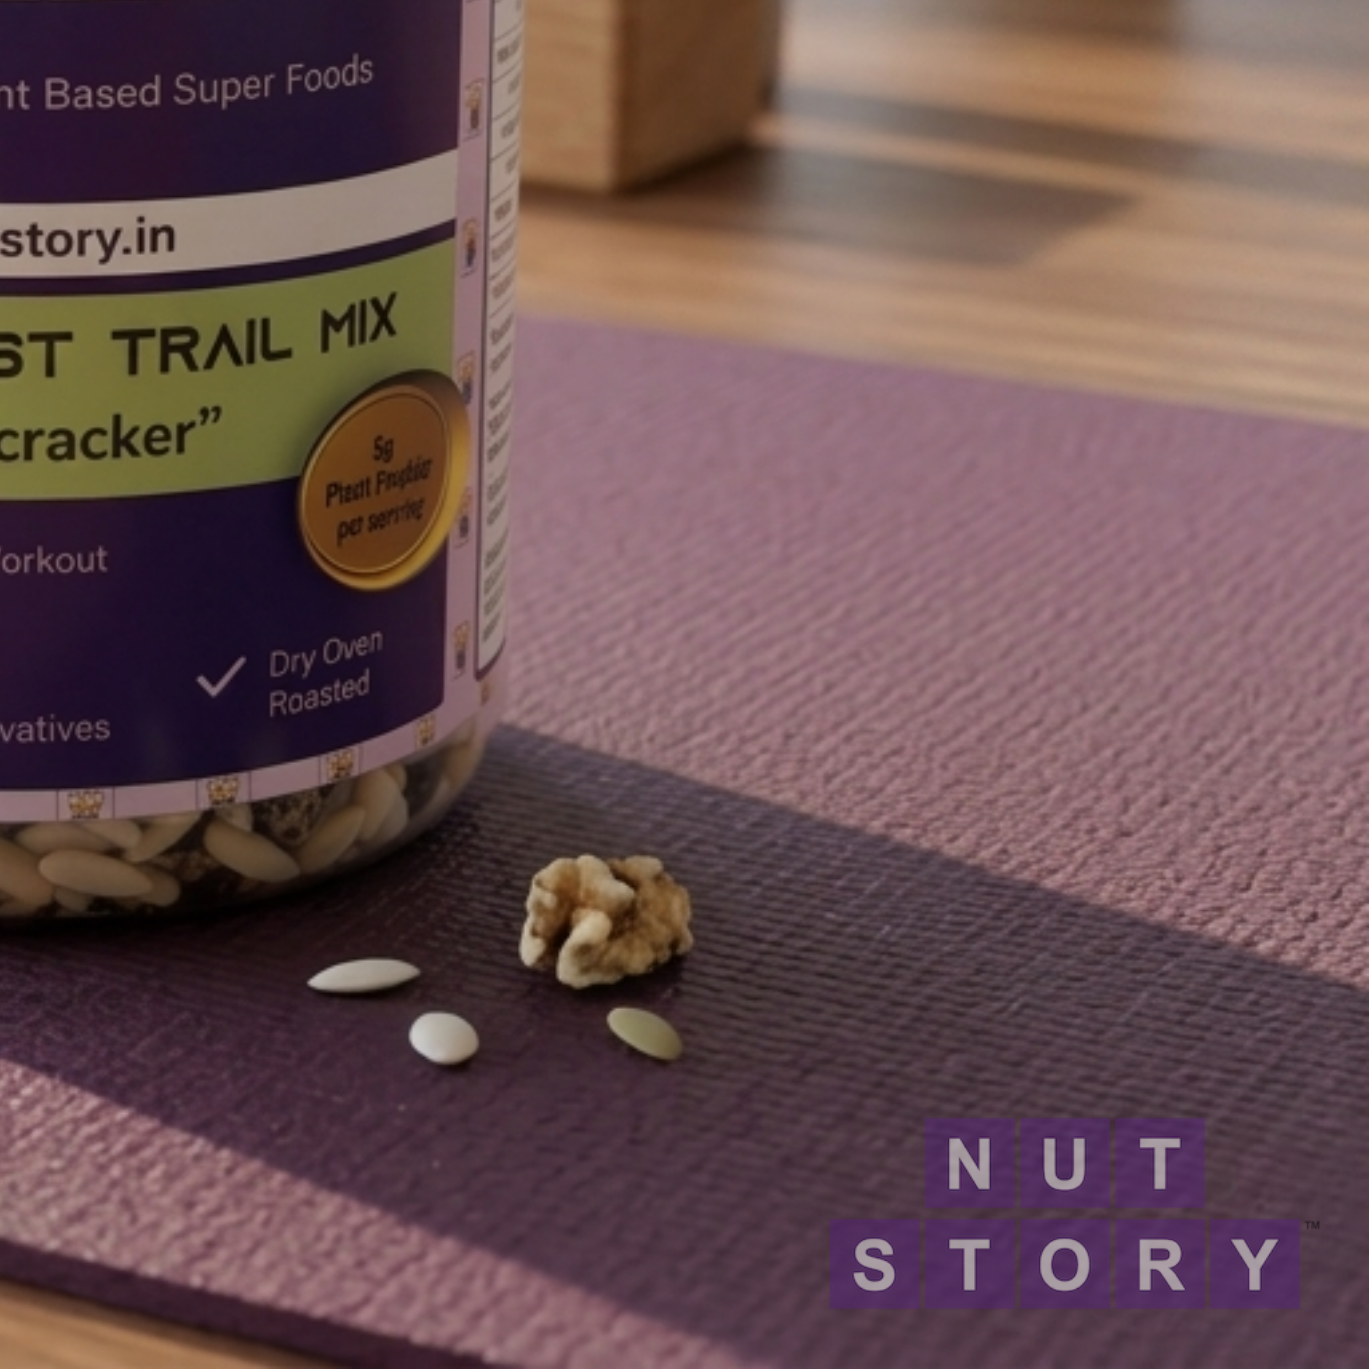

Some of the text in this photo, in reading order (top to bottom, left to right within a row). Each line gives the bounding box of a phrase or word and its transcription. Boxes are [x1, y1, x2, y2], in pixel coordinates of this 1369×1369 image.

[44, 73, 163, 111] Based
[172, 71, 276, 110] Super
[285, 52, 374, 96] Foods
[111, 317, 293, 376] TRAIL
[320, 291, 398, 353] MIX
[269, 631, 384, 679] Dry Oven
[269, 667, 371, 718] Roasted
